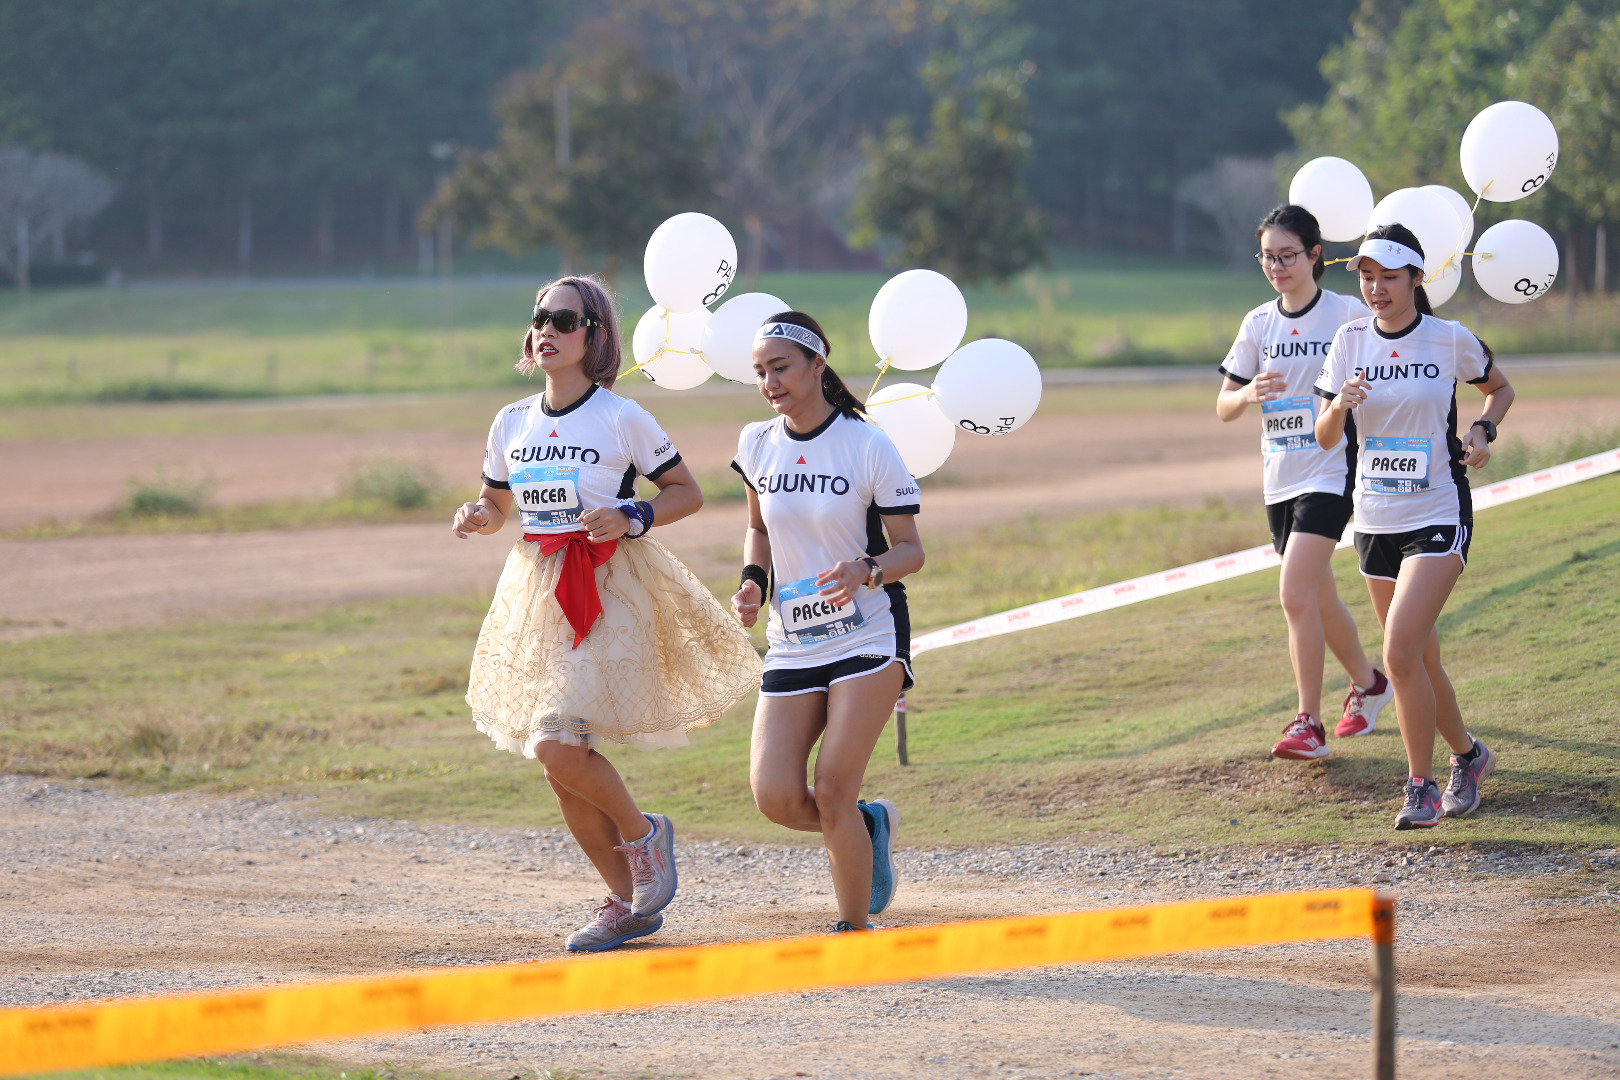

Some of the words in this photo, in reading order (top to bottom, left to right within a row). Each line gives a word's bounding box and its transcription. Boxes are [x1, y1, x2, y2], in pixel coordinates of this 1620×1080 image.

[1521, 174, 1545, 193] 8
[1513, 278, 1539, 296] 8
[959, 419, 991, 435] 8
[1267, 415, 1303, 432] PACER
[510, 445, 600, 465] SUUNTO
[1371, 457, 1417, 472] PACER
[758, 473, 850, 495] SUUNTO
[522, 487, 567, 505] PACER
